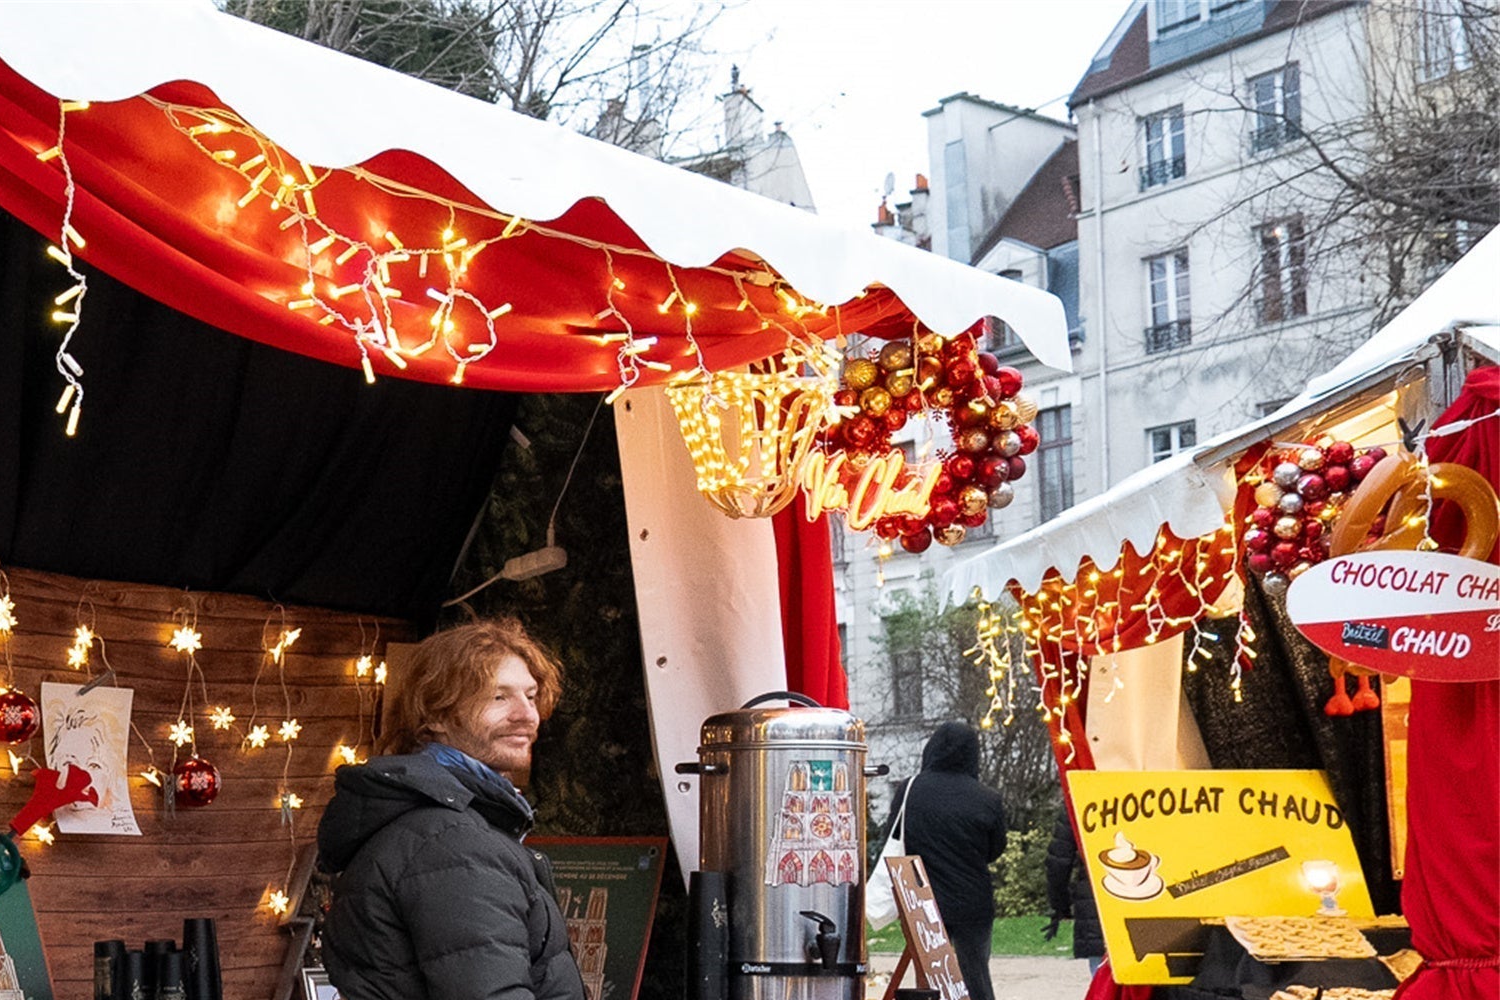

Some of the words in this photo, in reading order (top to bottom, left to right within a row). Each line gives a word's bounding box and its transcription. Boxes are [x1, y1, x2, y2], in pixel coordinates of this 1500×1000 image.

[804, 450, 849, 522] Vin
[1331, 560, 1449, 595] CHOCOLAT
[1390, 626, 1472, 660] CHAUD
[1082, 786, 1224, 833] CHOCOLAT
[1238, 788, 1346, 830] CHAUD
